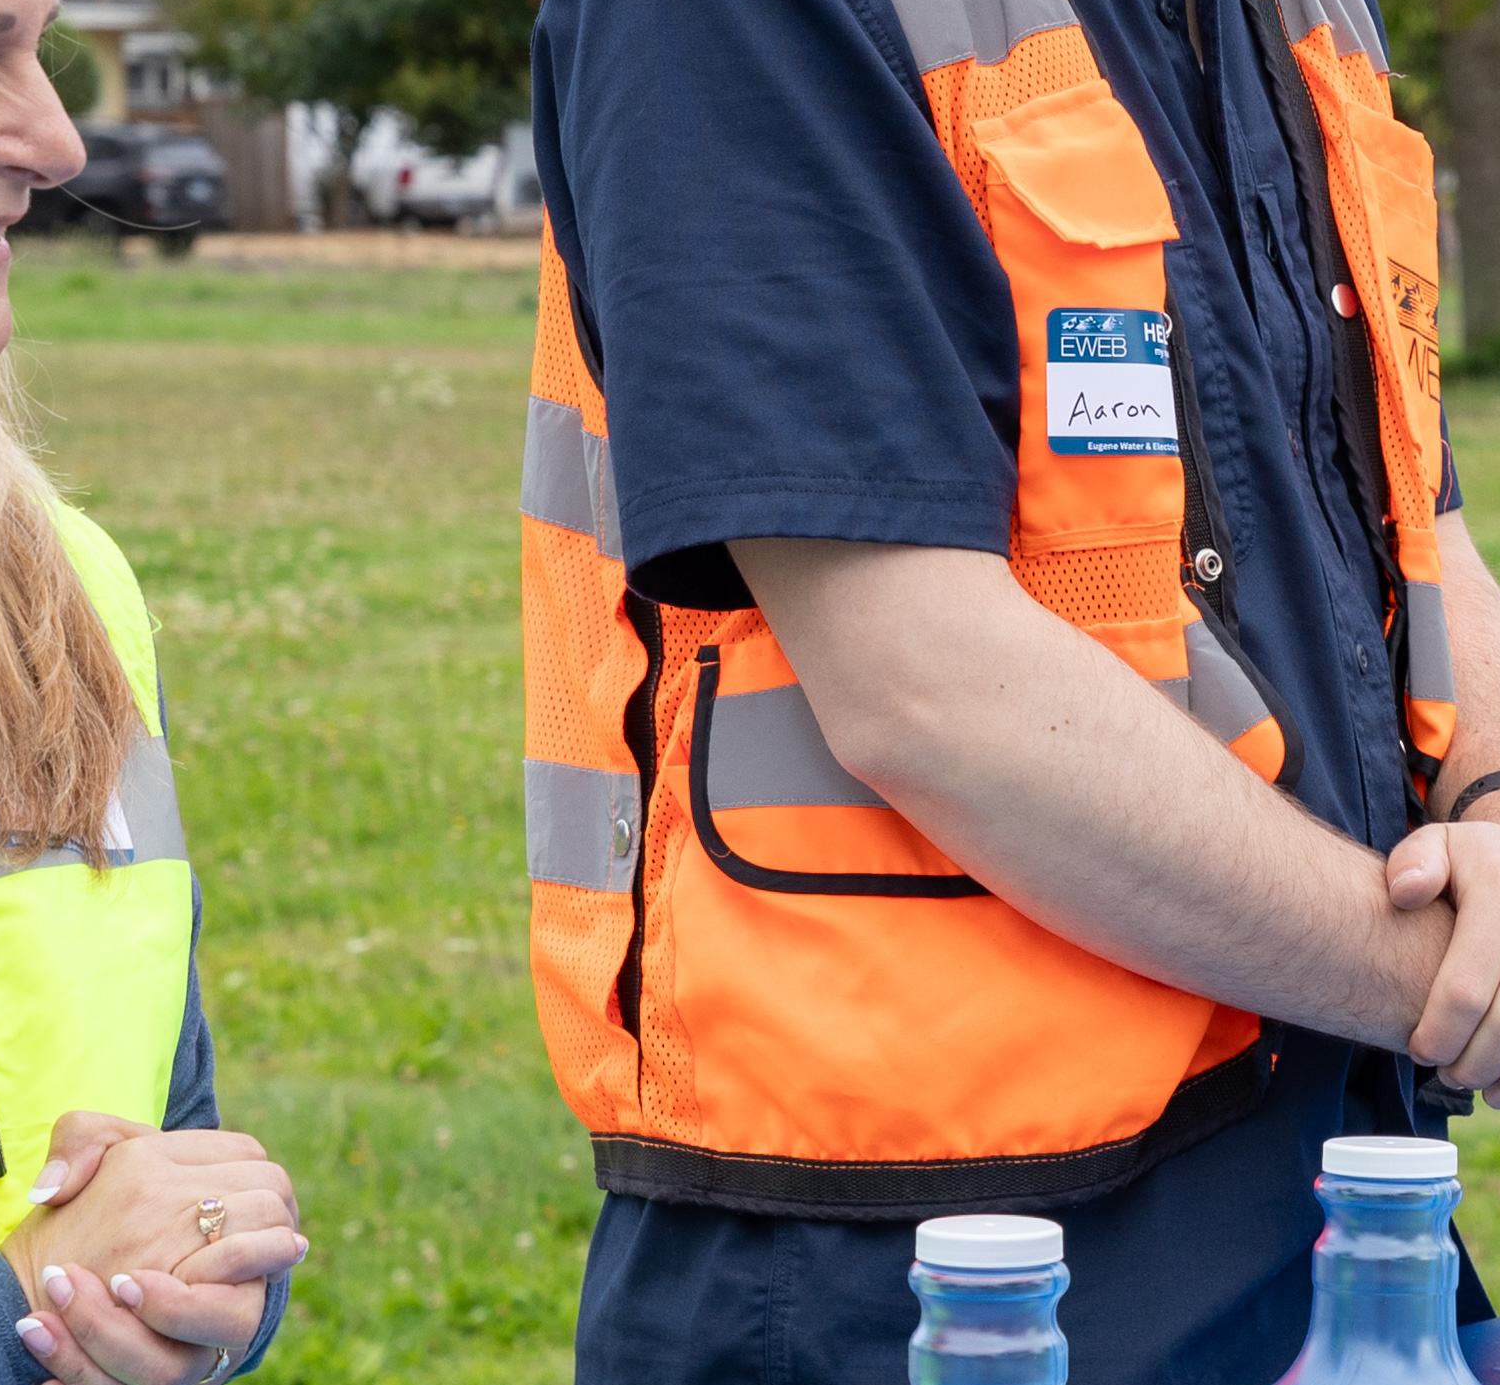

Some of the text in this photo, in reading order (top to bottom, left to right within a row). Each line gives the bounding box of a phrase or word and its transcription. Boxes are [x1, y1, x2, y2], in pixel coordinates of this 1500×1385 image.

[1061, 336, 1128, 357] EWEB
[1067, 391, 1161, 427] Aaron
[1087, 442, 1119, 453] Eugene
[1120, 442, 1144, 451] Water
